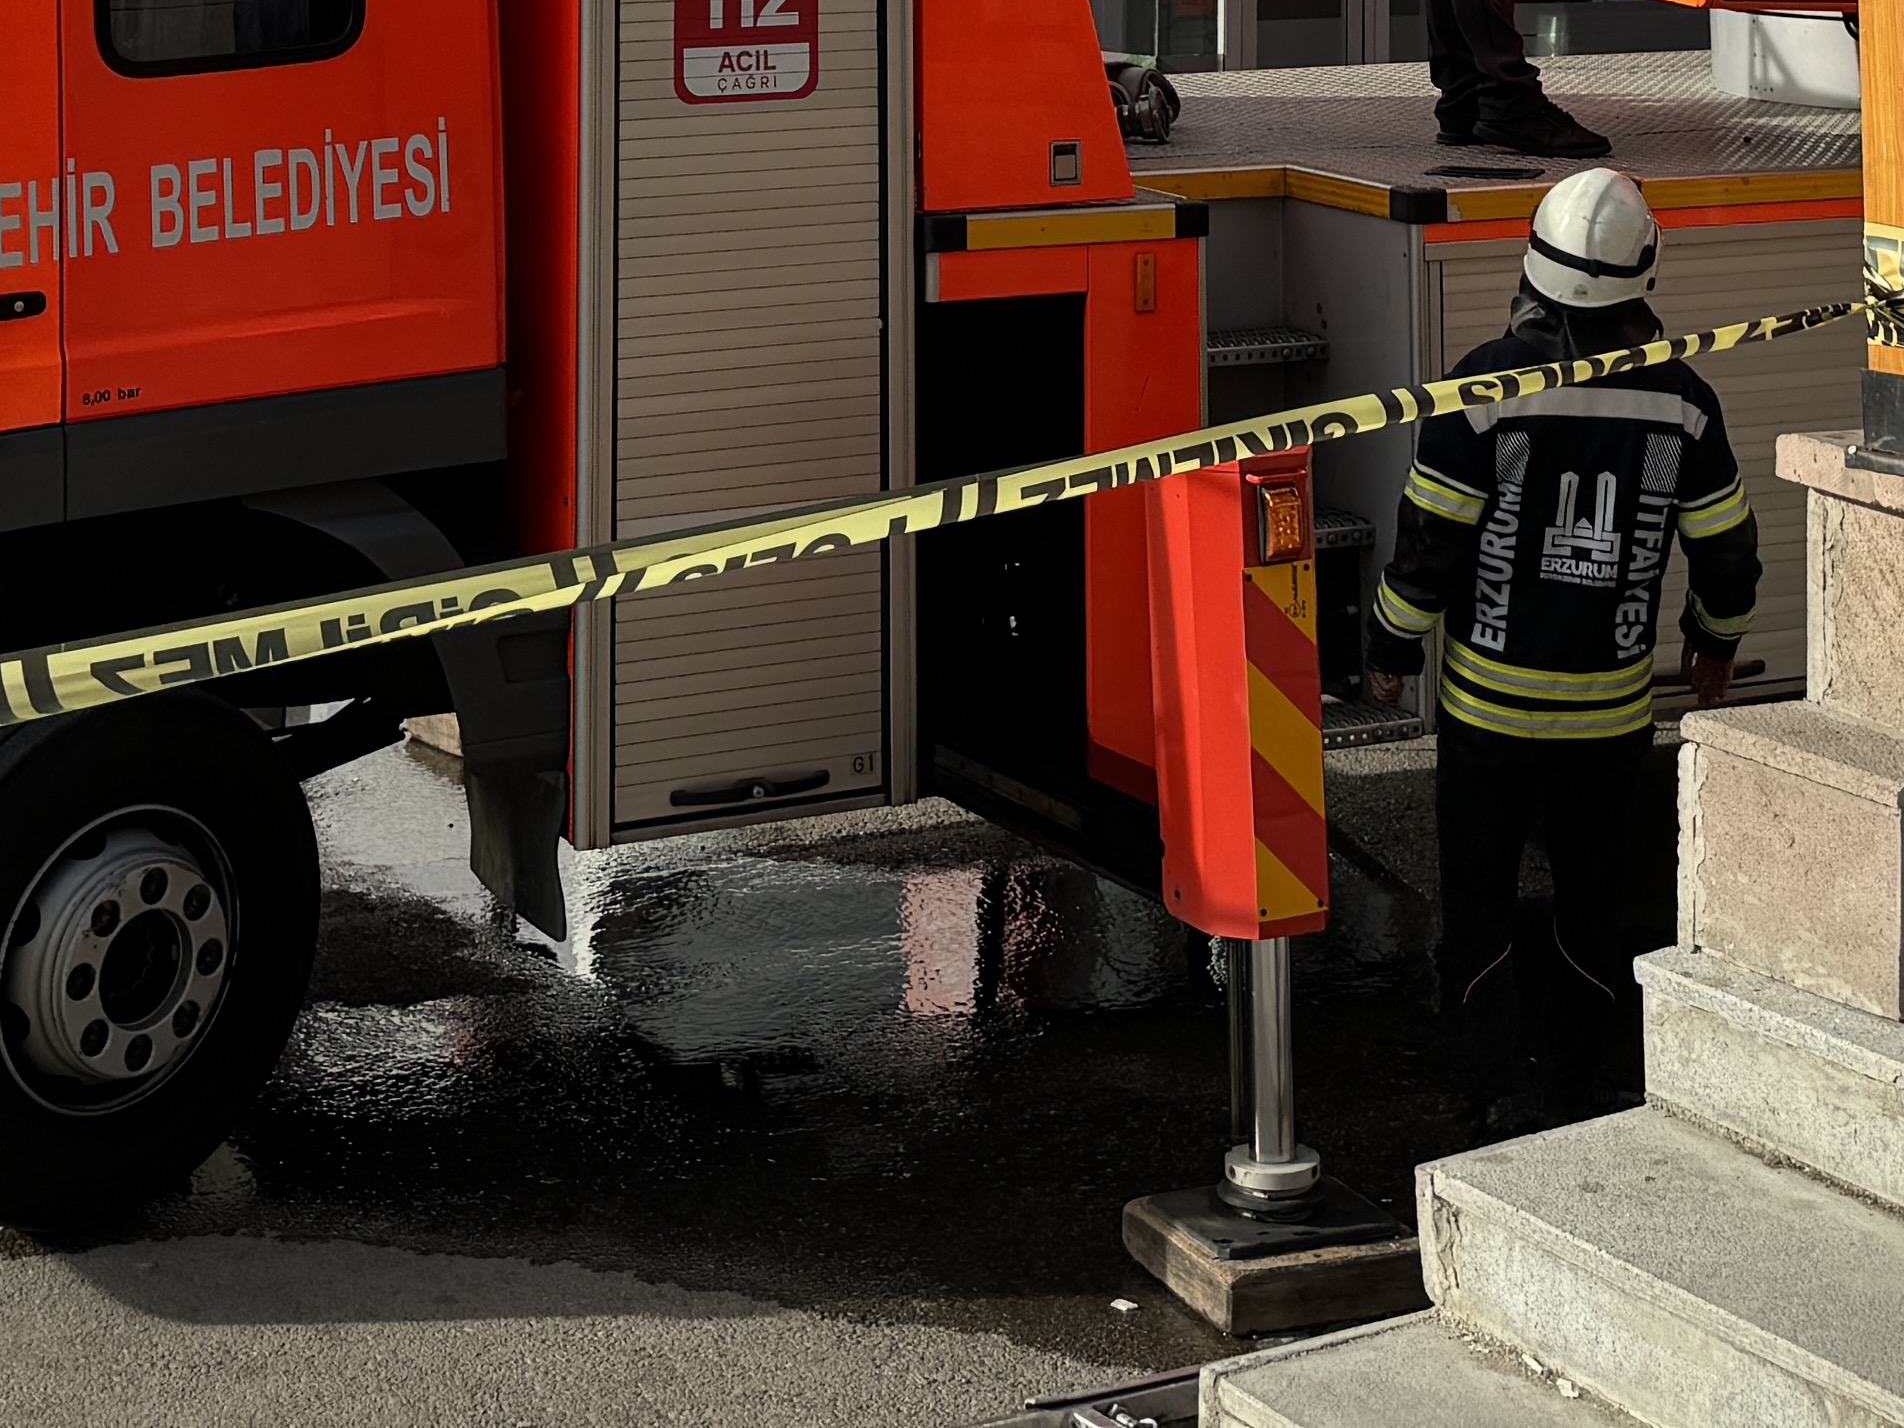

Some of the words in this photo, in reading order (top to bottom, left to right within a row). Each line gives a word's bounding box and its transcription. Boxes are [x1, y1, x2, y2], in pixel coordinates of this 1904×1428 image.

[717, 75, 777, 93] ÇAĞRI
[151, 116, 451, 248] BELEDİYESİ
[117, 387, 142, 400] bar
[1471, 480, 1524, 653] ERZURUM
[1540, 557, 1619, 580] ERZURUM
[1614, 493, 1680, 660] İTFAİYESİ
